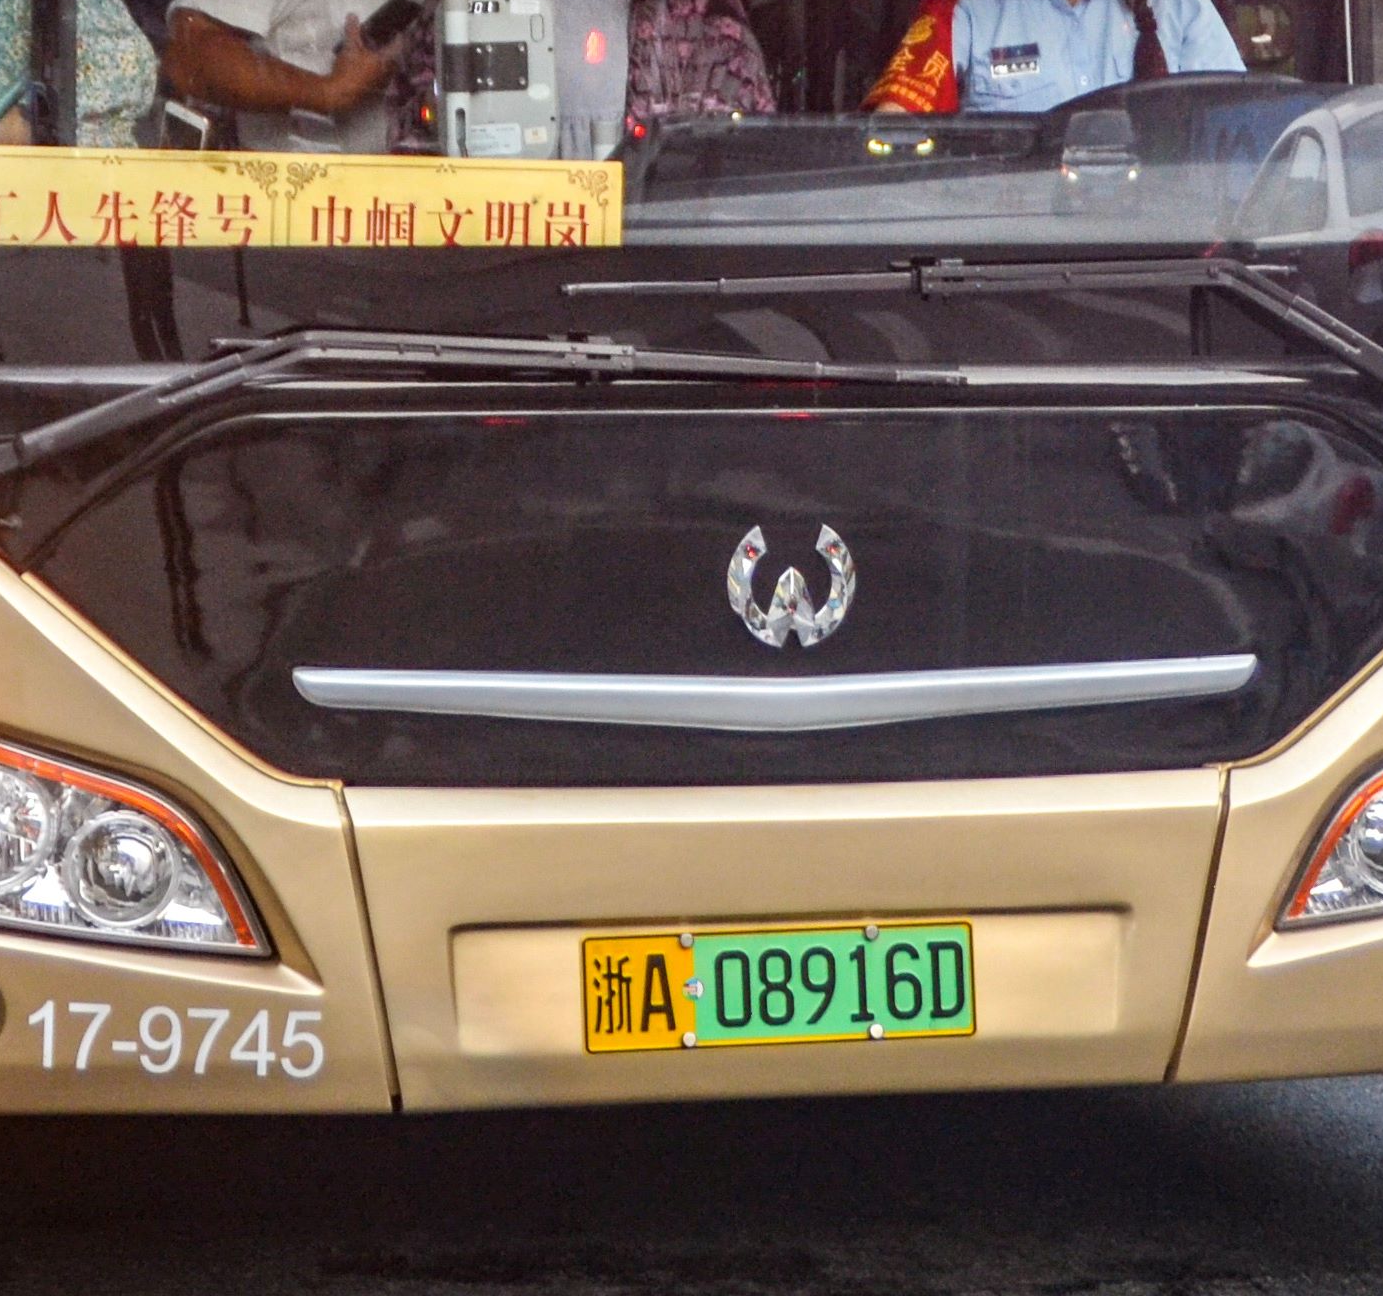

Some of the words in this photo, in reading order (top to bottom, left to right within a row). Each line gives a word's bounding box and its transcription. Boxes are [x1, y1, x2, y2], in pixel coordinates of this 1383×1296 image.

[310, 194, 590, 247] 巾帼文明岗
[592, 953, 677, 1035] 浙A
[714, 940, 966, 1029] 08916D
[28, 999, 325, 1078] 17-9745
